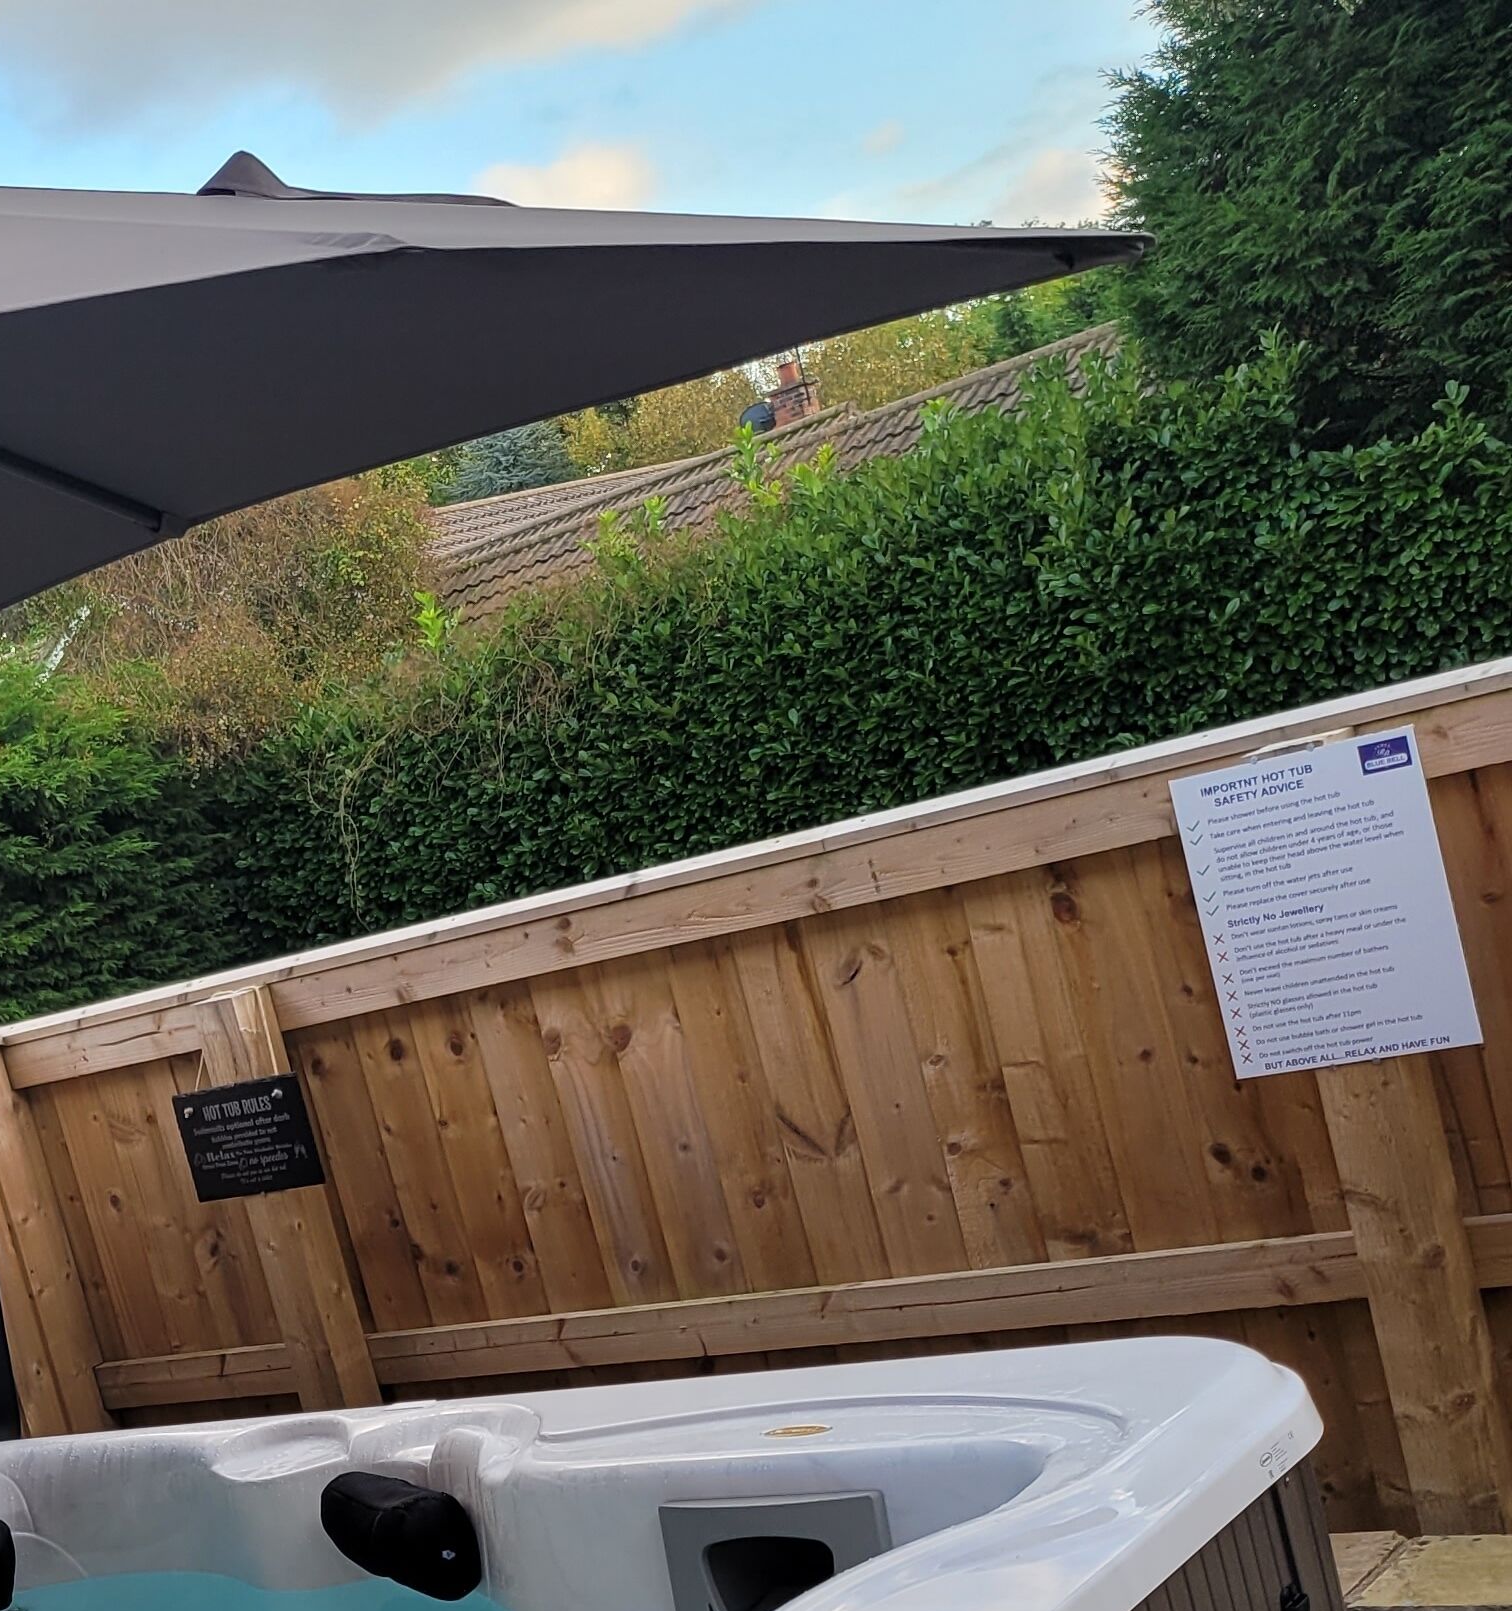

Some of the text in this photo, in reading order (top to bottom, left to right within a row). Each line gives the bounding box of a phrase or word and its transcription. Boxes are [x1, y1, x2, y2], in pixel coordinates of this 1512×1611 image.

[1200, 764, 1313, 797] IMPORTNT HOT TUB
[1214, 779, 1305, 807] SAFETY ADVICE
[1230, 810, 1255, 820] shower
[1256, 805, 1280, 815] before
[1281, 801, 1300, 811] using
[1242, 824, 1260, 833] when
[1263, 817, 1292, 830] entering
[1293, 814, 1306, 822] and
[1308, 808, 1333, 820] leaving
[1334, 805, 1347, 813] the
[1361, 799, 1375, 807] tub
[1257, 834, 1285, 845] children
[1295, 829, 1308, 837] and
[1310, 823, 1335, 834] around
[1380, 811, 1394, 819] and
[1259, 844, 1287, 854] children
[1288, 839, 1309, 848] under
[1317, 835, 1336, 844] years
[1372, 822, 1393, 831] those
[1252, 857, 1268, 867] keep
[1288, 850, 1305, 858] head
[1329, 842, 1342, 850] the
[1266, 865, 1278, 873] hot
[1273, 879, 1285, 887] the
[1322, 869, 1339, 877] after
[1228, 903, 1325, 930] Strictly No Jewellery
[1264, 1036, 1450, 1070] BUT ABOVE RELAX AND HAVE FUN
[202, 1095, 272, 1122] HOT TUB RULES
